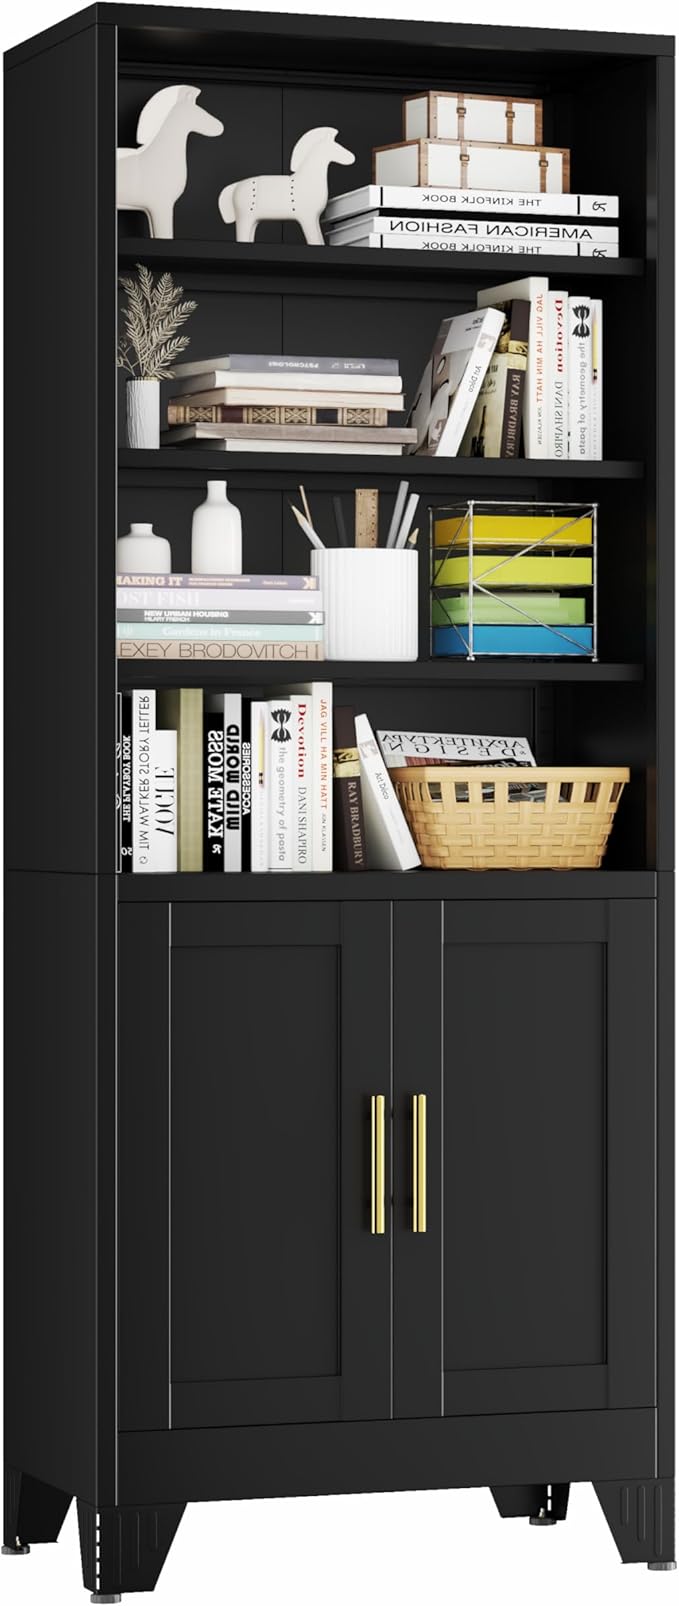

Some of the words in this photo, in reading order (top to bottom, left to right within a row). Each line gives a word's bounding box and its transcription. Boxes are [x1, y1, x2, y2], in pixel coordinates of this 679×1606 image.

[169, 576, 183, 586] IT
[144, 610, 163, 618] NEW
[193, 611, 230, 619] HOUSING
[179, 642, 309, 659] BRODOVITCH
[320, 699, 328, 719] JAG
[297, 703, 307, 778] Devotion
[320, 722, 328, 743] VILL
[278, 747, 287, 764] the
[320, 746, 328, 760] HA
[320, 763, 328, 781] MIN
[276, 766, 287, 816] geometry
[298, 787, 307, 814] DANI
[320, 784, 328, 811] HATT
[347, 781, 358, 805] RAY
[278, 819, 287, 830] of
[298, 816, 307, 864] SHAPIRO
[350, 807, 364, 866] BRADBURY
[276, 833, 287, 862] pasta
